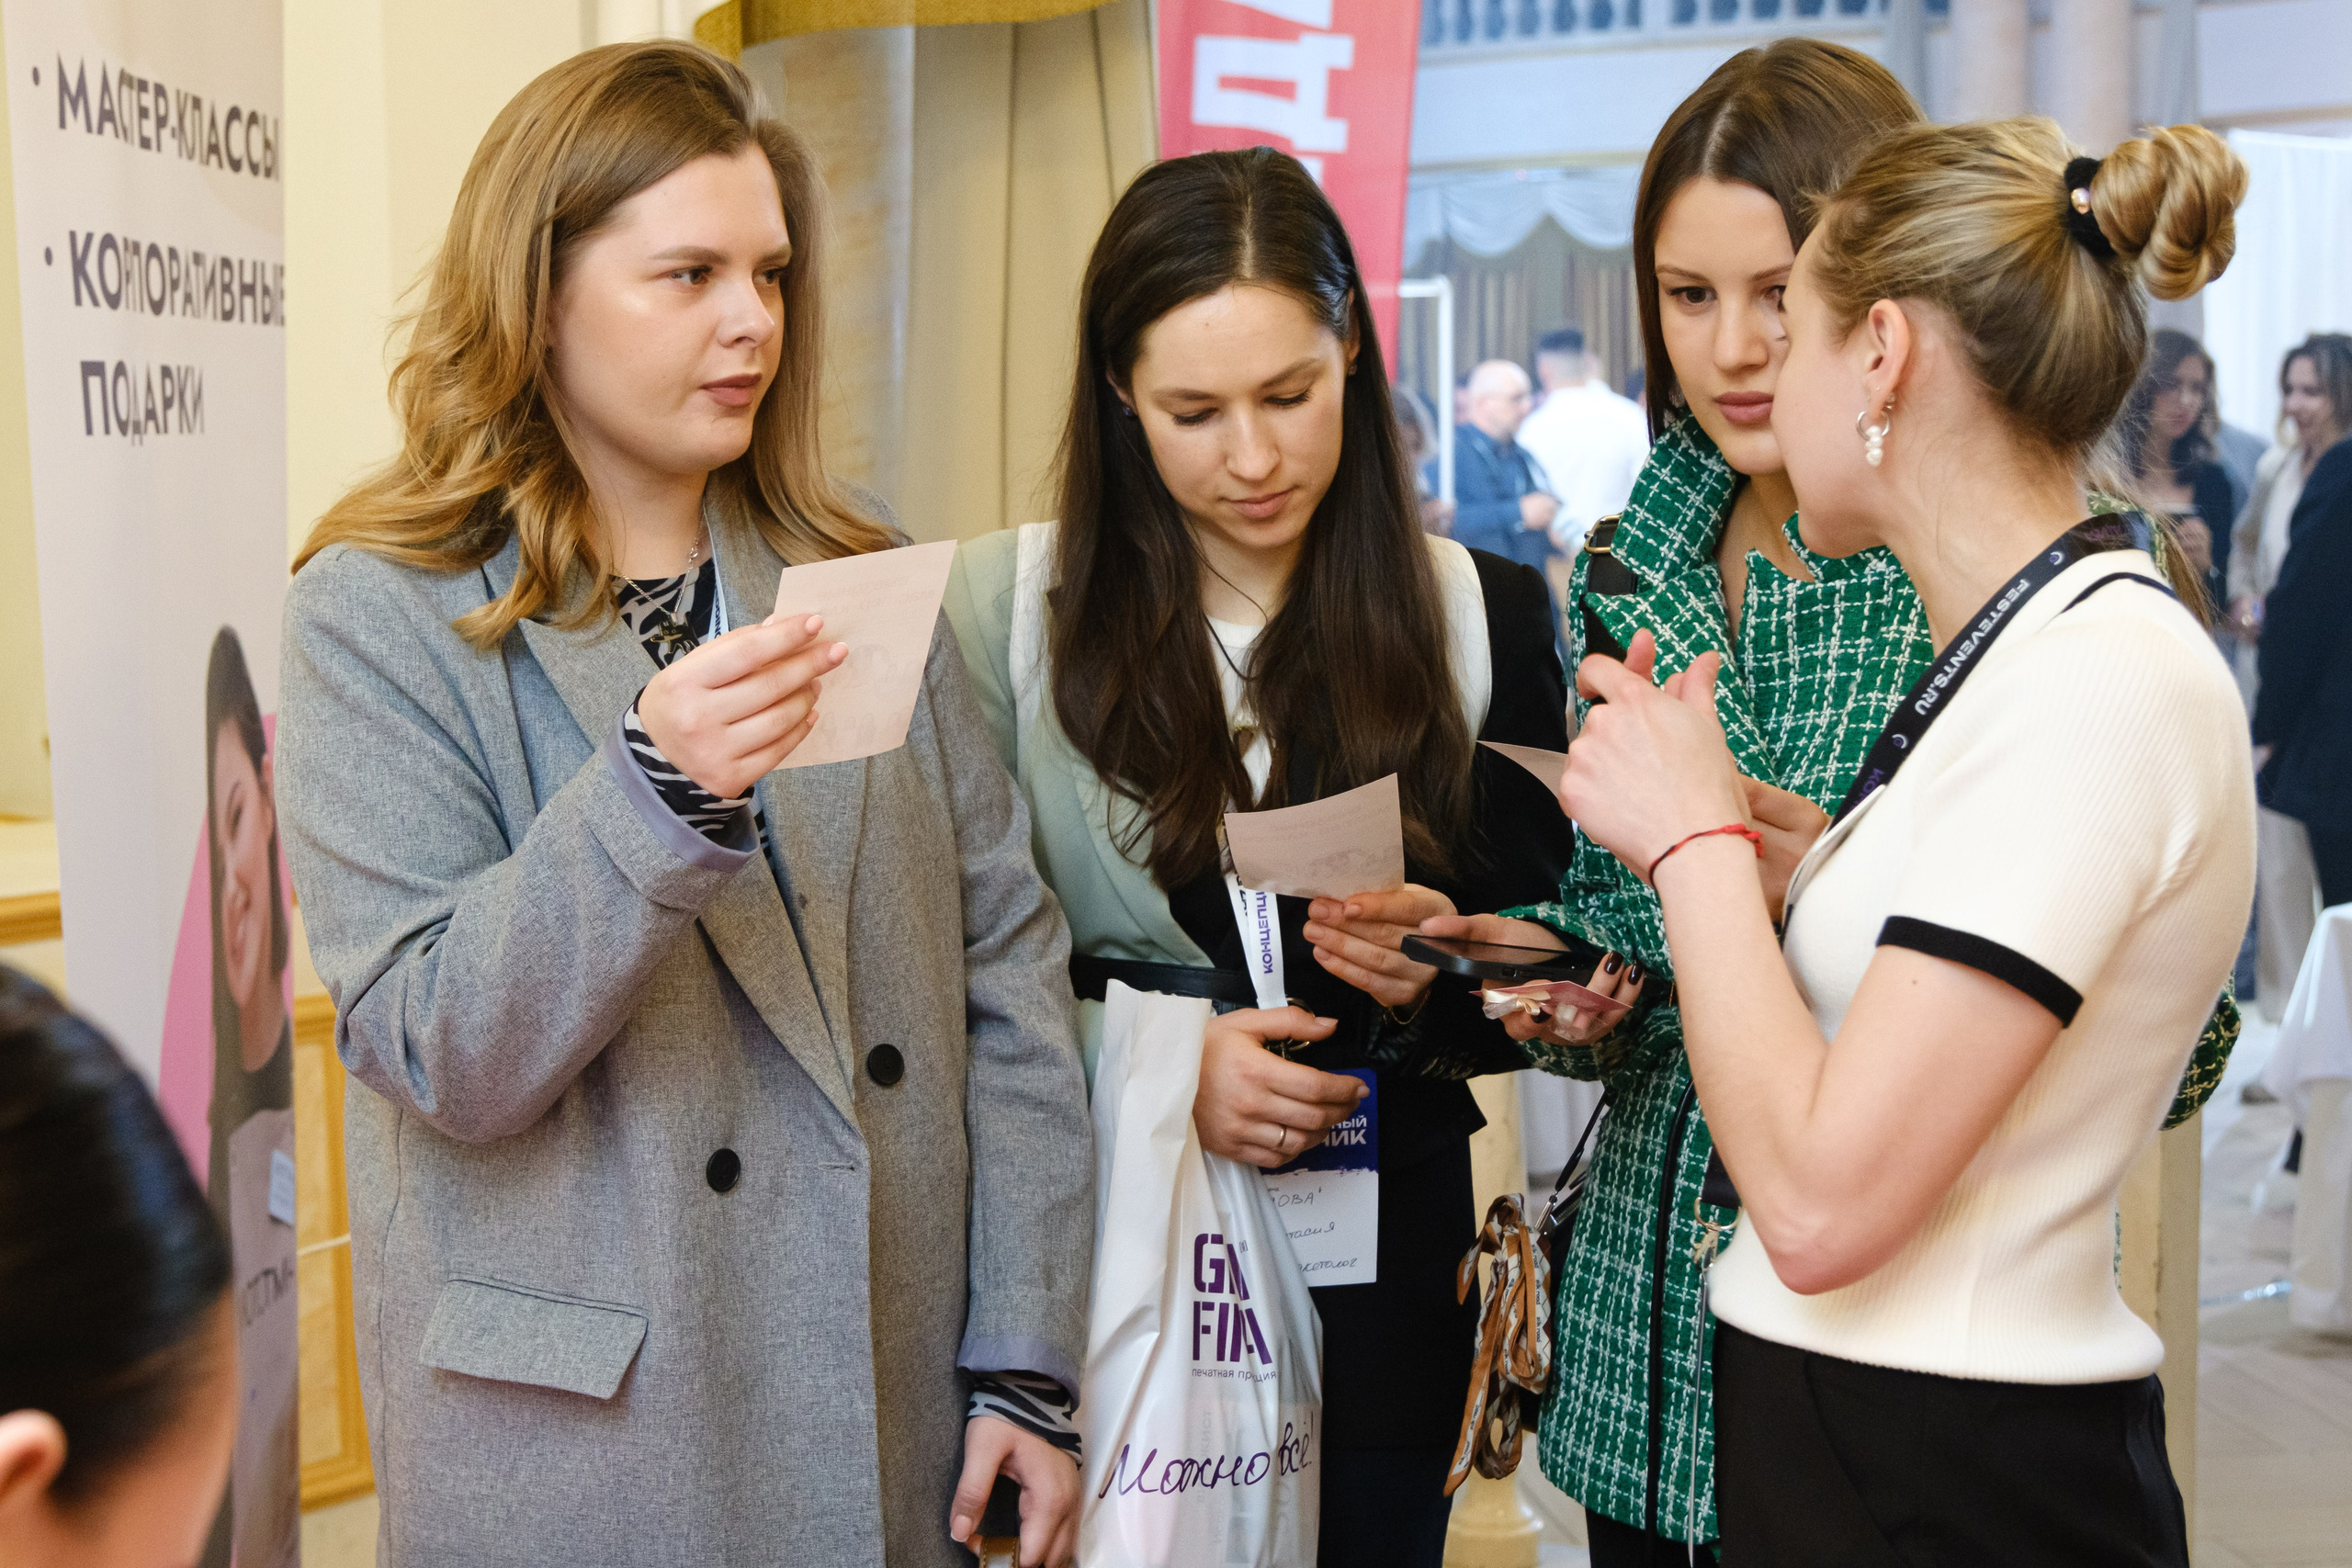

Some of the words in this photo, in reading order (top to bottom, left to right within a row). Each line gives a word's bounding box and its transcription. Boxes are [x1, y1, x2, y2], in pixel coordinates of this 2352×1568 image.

[57, 51, 279, 182] МАСТЕР-КЛАССЫ
[69, 230, 285, 327] КОРПОРАТИВНЫЕ
[80, 359, 206, 447] ПОДАРКИ
[1914, 578, 2031, 716] FESTEVENTS.RU
[1286, 1221, 1336, 1238] тасия
[1192, 1368, 1235, 1378] печатная
[1098, 1443, 1271, 1499] Можно
